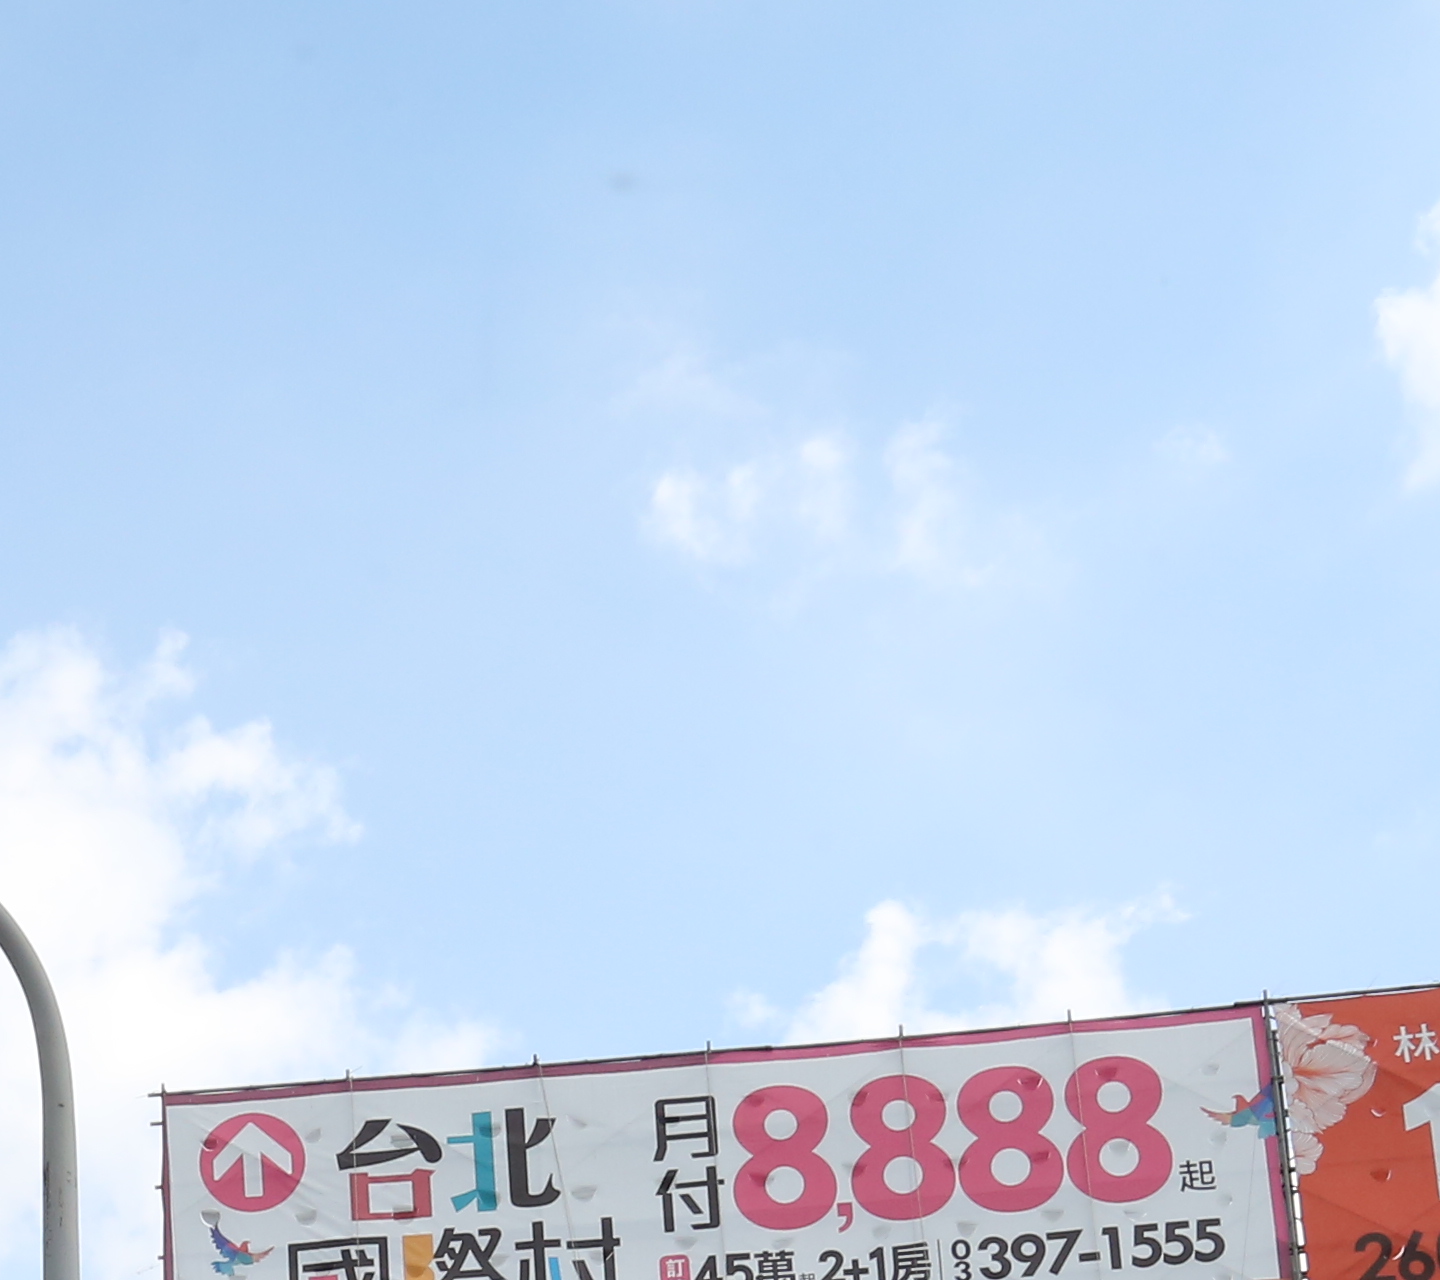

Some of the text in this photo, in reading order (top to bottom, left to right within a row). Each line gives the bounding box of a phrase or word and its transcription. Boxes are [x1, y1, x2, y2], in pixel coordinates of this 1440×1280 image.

[336, 1107, 561, 1221] 台北
[654, 1096, 724, 1232] 月付
[732, 1056, 1217, 1233] 8,888 起
[978, 1218, 1226, 1277] 397-1555
